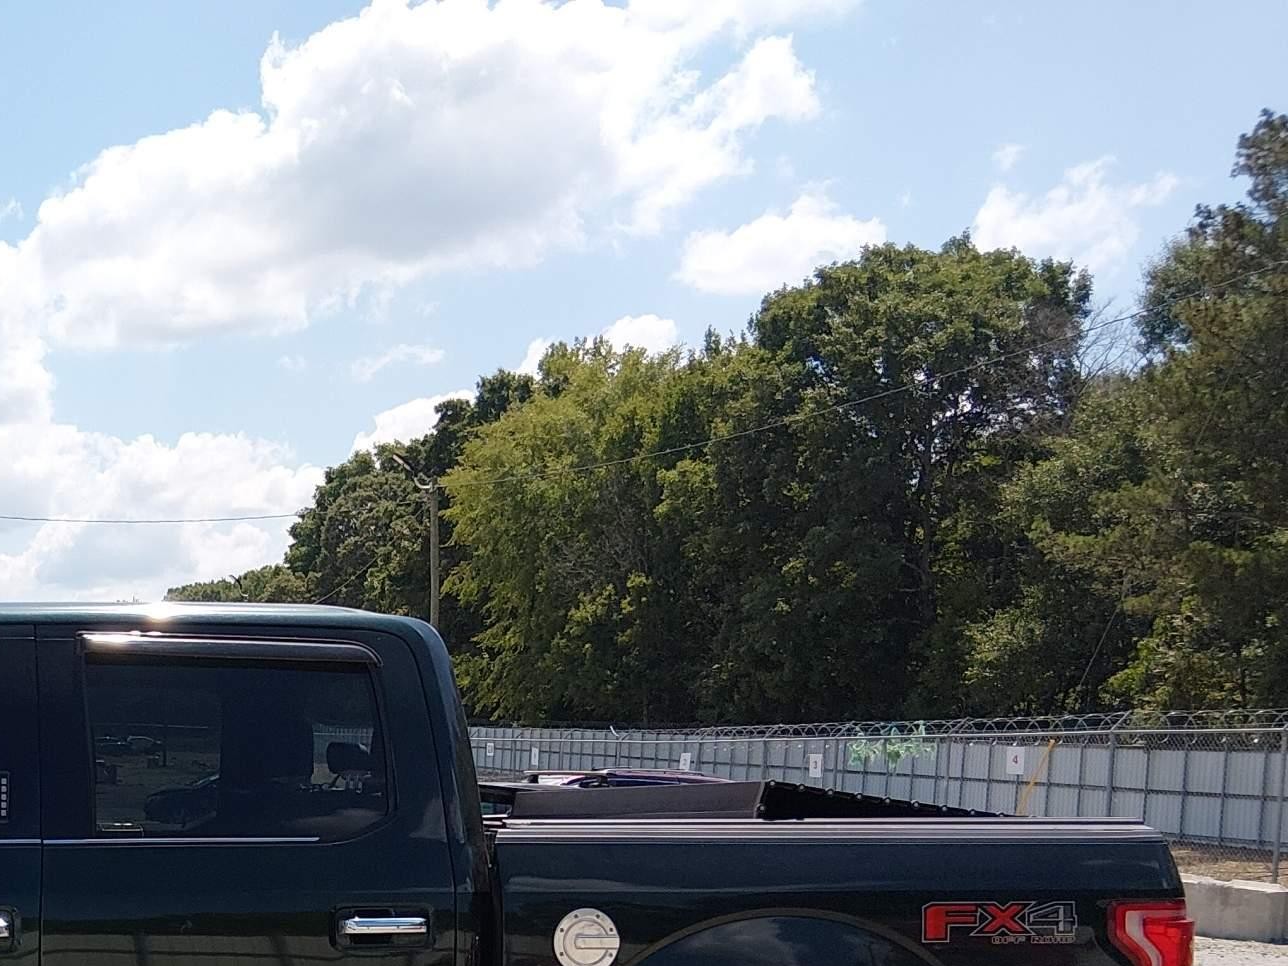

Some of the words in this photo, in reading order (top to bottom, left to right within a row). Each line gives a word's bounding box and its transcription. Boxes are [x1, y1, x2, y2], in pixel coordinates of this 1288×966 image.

[1012, 755, 1018, 764] 4
[922, 901, 1078, 943] FX4
[992, 935, 1026, 944] OFF
[1030, 935, 1076, 944] ROAD
